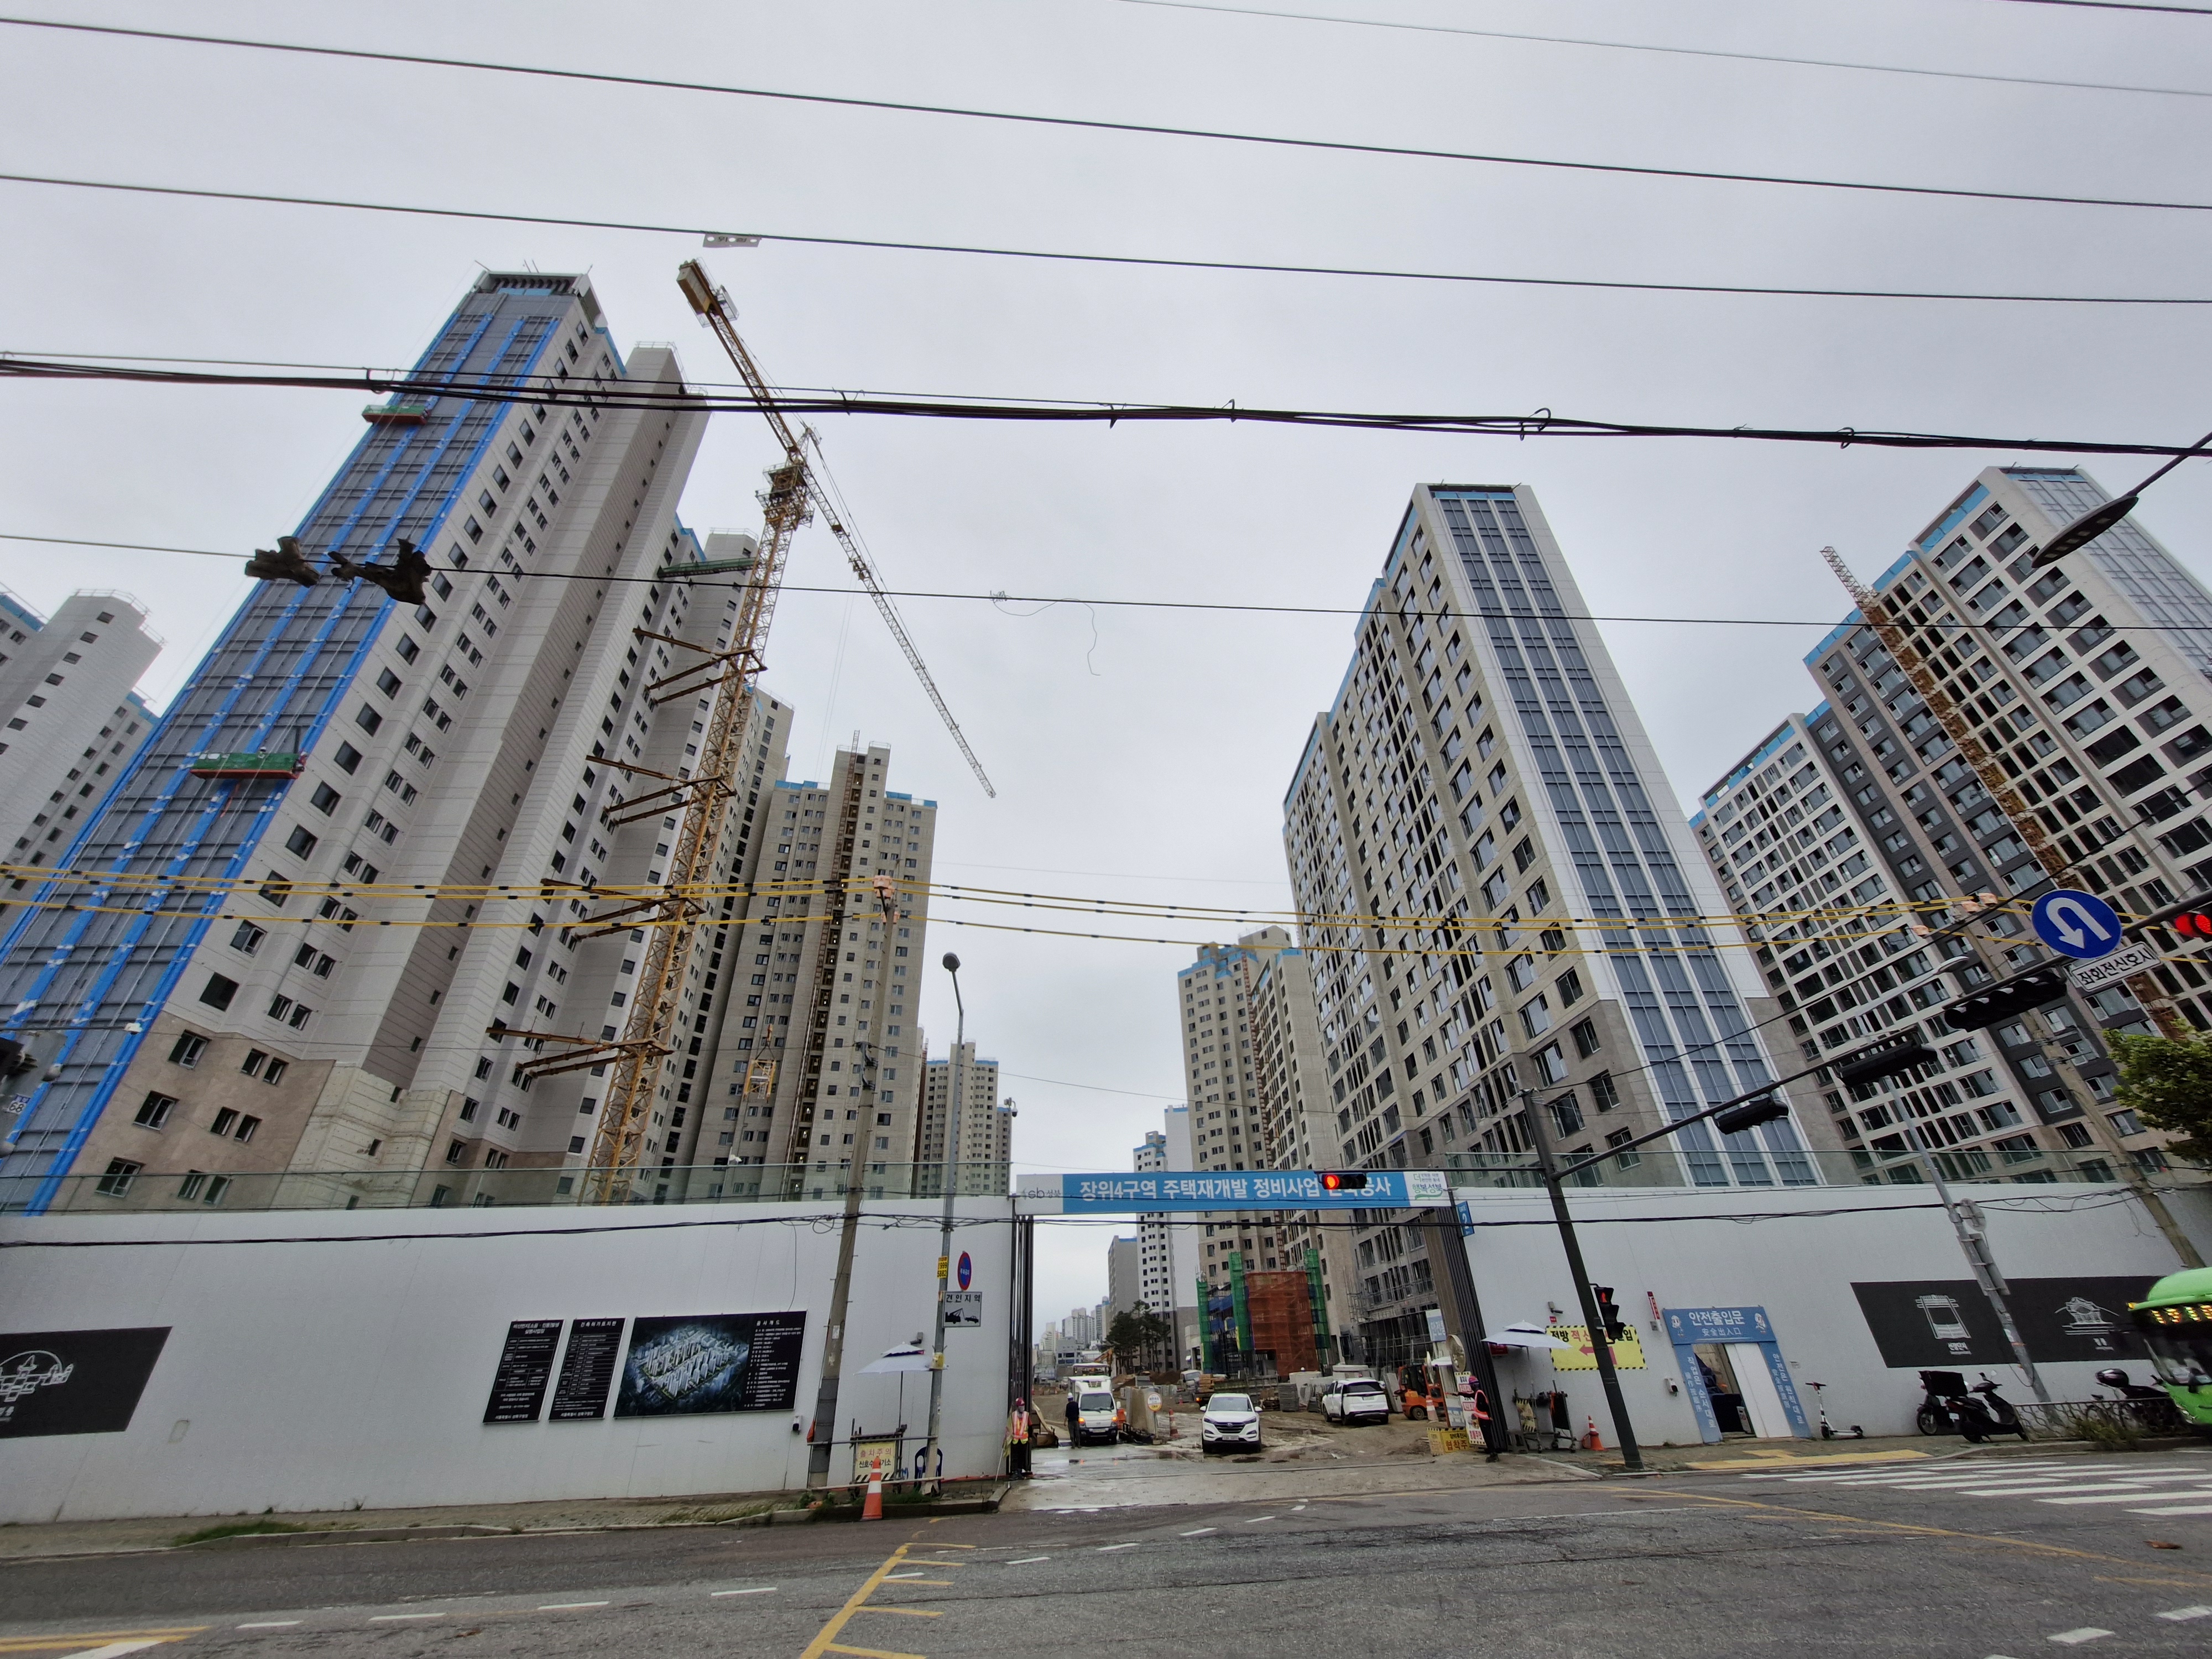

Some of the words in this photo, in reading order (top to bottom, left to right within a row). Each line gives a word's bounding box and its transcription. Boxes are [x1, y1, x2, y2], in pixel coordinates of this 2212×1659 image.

[2077, 947, 2156, 985] 좌회전신호시
[9, 1102, 24, 1113] 68
[1080, 1180, 1156, 1201] 장위4구역
[1163, 1178, 1248, 1199] 주택재개발
[1254, 1177, 1321, 1198] 정비사업
[1688, 1311, 1745, 1326] 안전출입문
[1702, 1328, 1742, 1337] 安全出入口
[859, 1458, 891, 1468] 신호수기소
